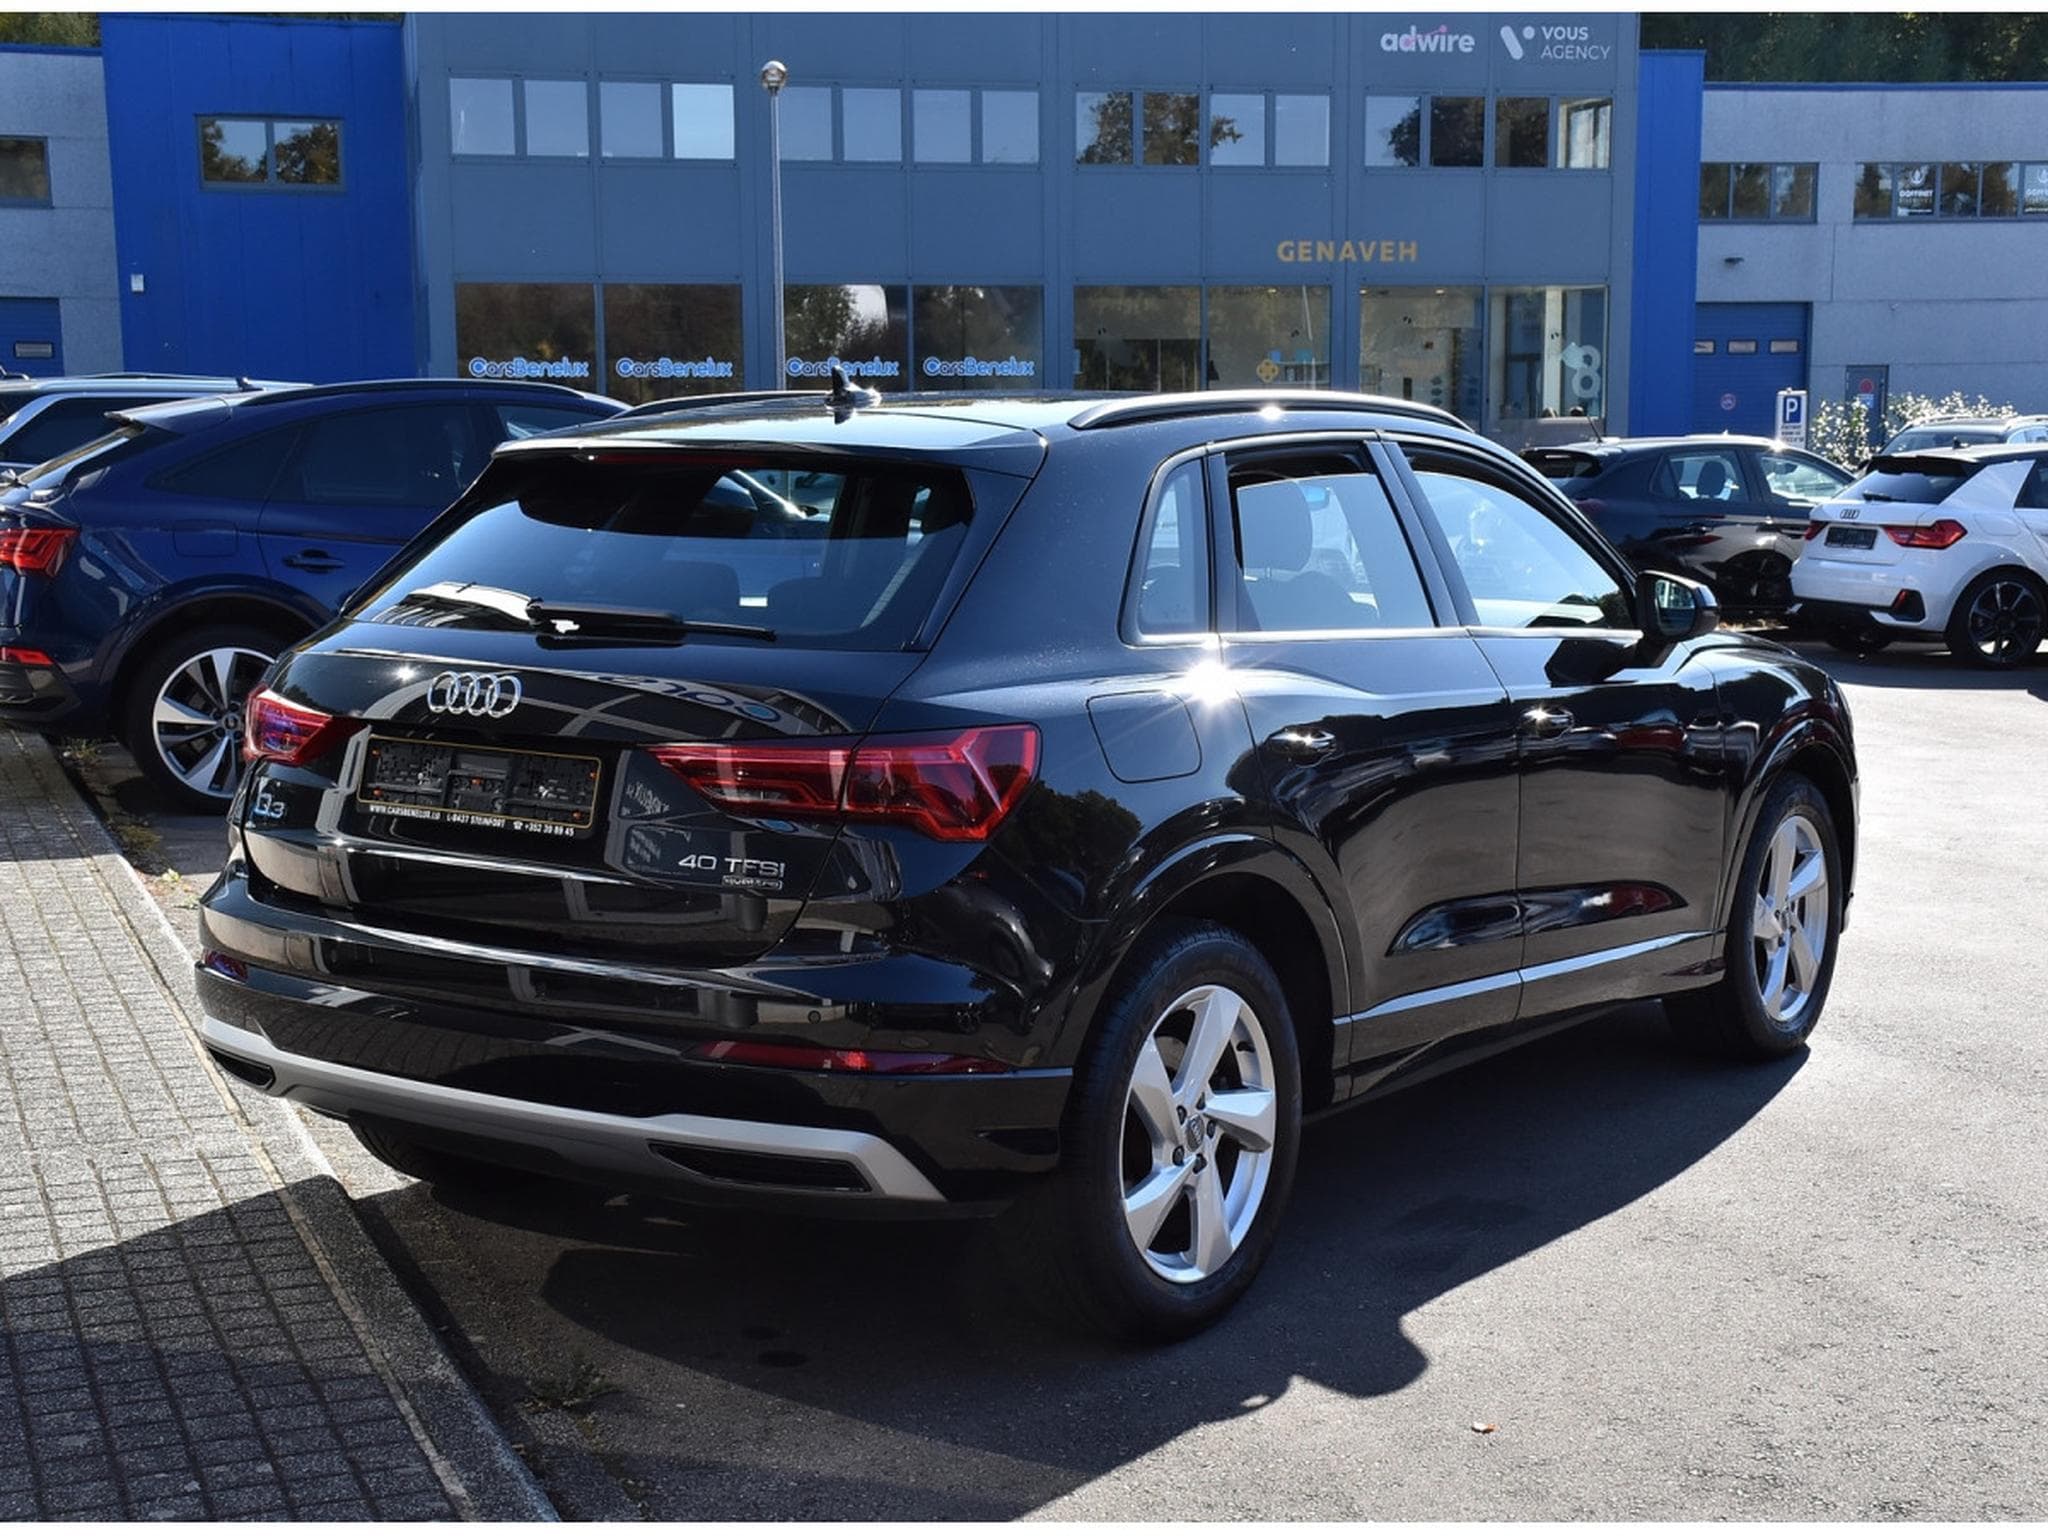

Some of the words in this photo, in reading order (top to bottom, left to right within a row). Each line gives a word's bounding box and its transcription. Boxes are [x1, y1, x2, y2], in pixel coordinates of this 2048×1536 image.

[1380, 25, 1475, 52] adwire
[1542, 26, 1588, 41] VOUS
[1540, 45, 1611, 60] AGENCY
[1277, 240, 1419, 263] GENAVEH
[468, 356, 590, 378] CarsBenelux
[615, 356, 734, 378] CarsBenelux
[922, 356, 1035, 378] CarsBenelux
[1785, 397, 1799, 422] P
[255, 792, 286, 819] Q3
[678, 854, 718, 870] 40
[724, 857, 786, 878] TFSI
